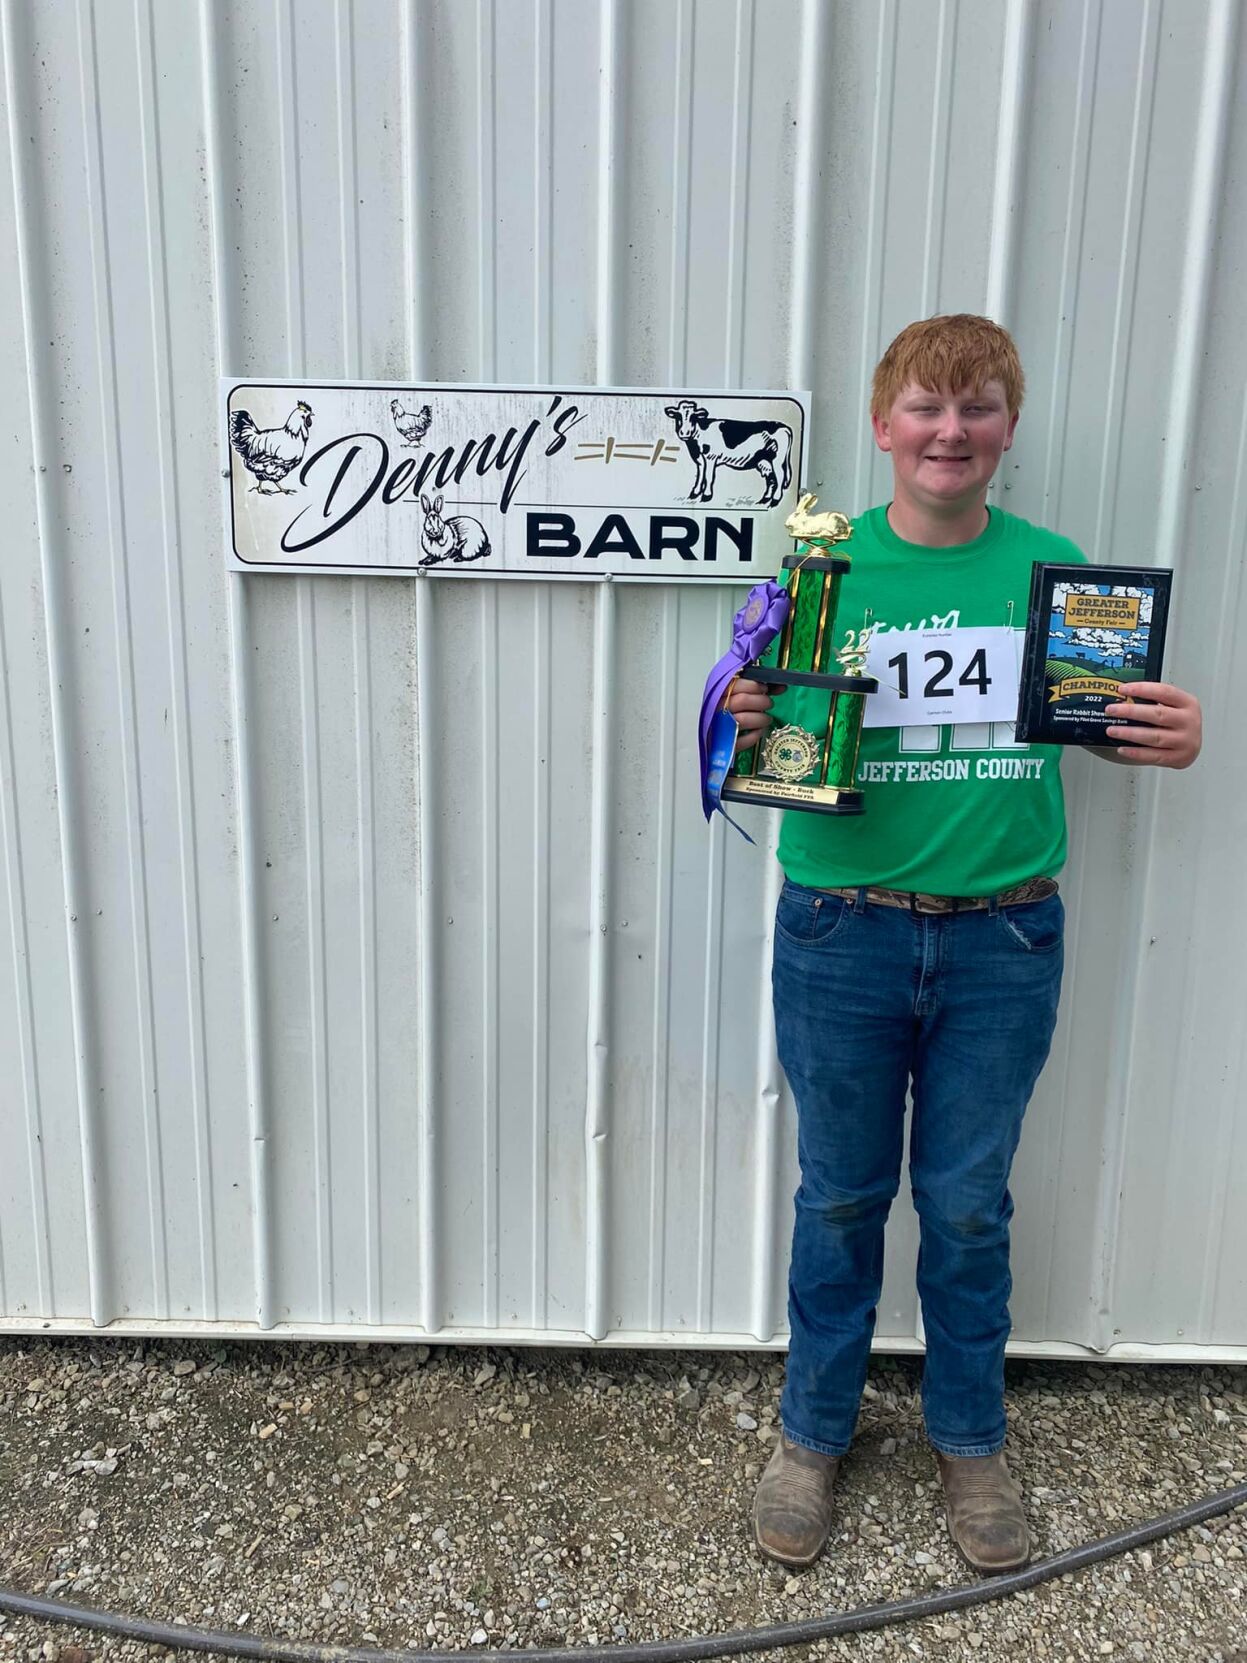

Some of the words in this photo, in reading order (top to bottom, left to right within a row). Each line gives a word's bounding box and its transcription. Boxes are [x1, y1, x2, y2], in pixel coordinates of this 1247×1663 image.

[281, 396, 589, 552] Denny's
[526, 512, 754, 562] BARN
[1068, 608, 1136, 619] JEFFERSON
[1077, 598, 1129, 609] GREATER
[888, 648, 992, 699] 124
[858, 759, 970, 782] JEFFERSON
[976, 758, 1044, 779] COUNTY
